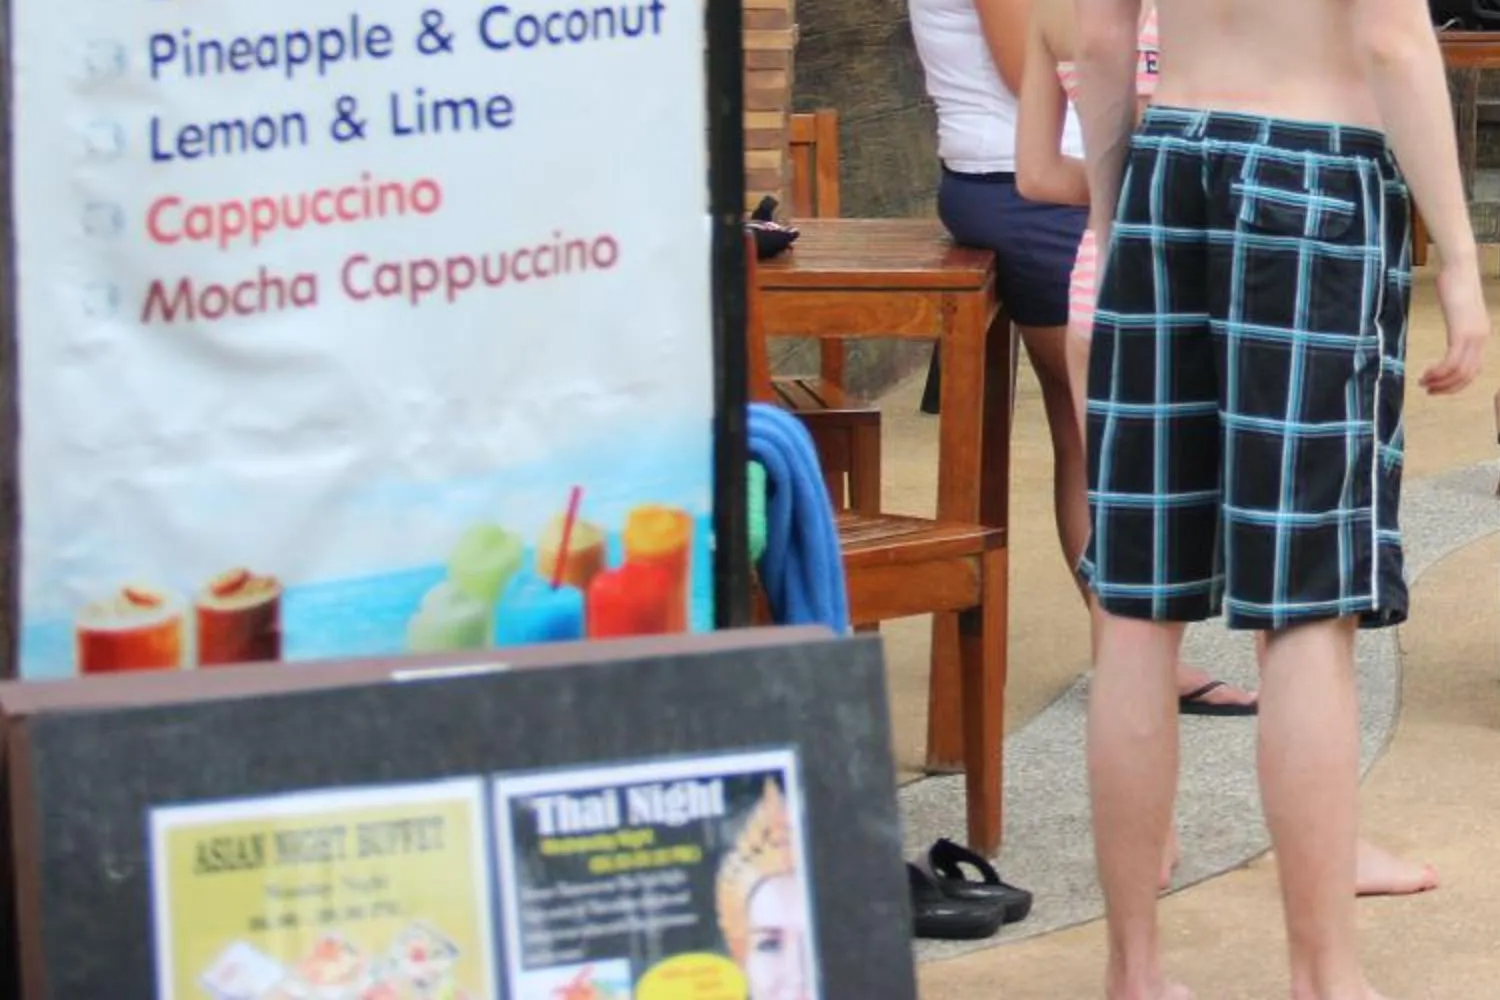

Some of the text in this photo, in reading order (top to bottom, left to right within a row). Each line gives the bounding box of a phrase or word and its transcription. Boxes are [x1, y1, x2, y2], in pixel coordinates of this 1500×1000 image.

[149, 15, 393, 79] Pineapple
[417, 10, 454, 55] &
[150, 89, 514, 162] Lemon & Lime
[146, 173, 443, 250] Cappuccino
[140, 231, 618, 325] Mocha Cappuccino
[536, 778, 725, 834] Thai Night
[194, 833, 265, 875] ASIAN
